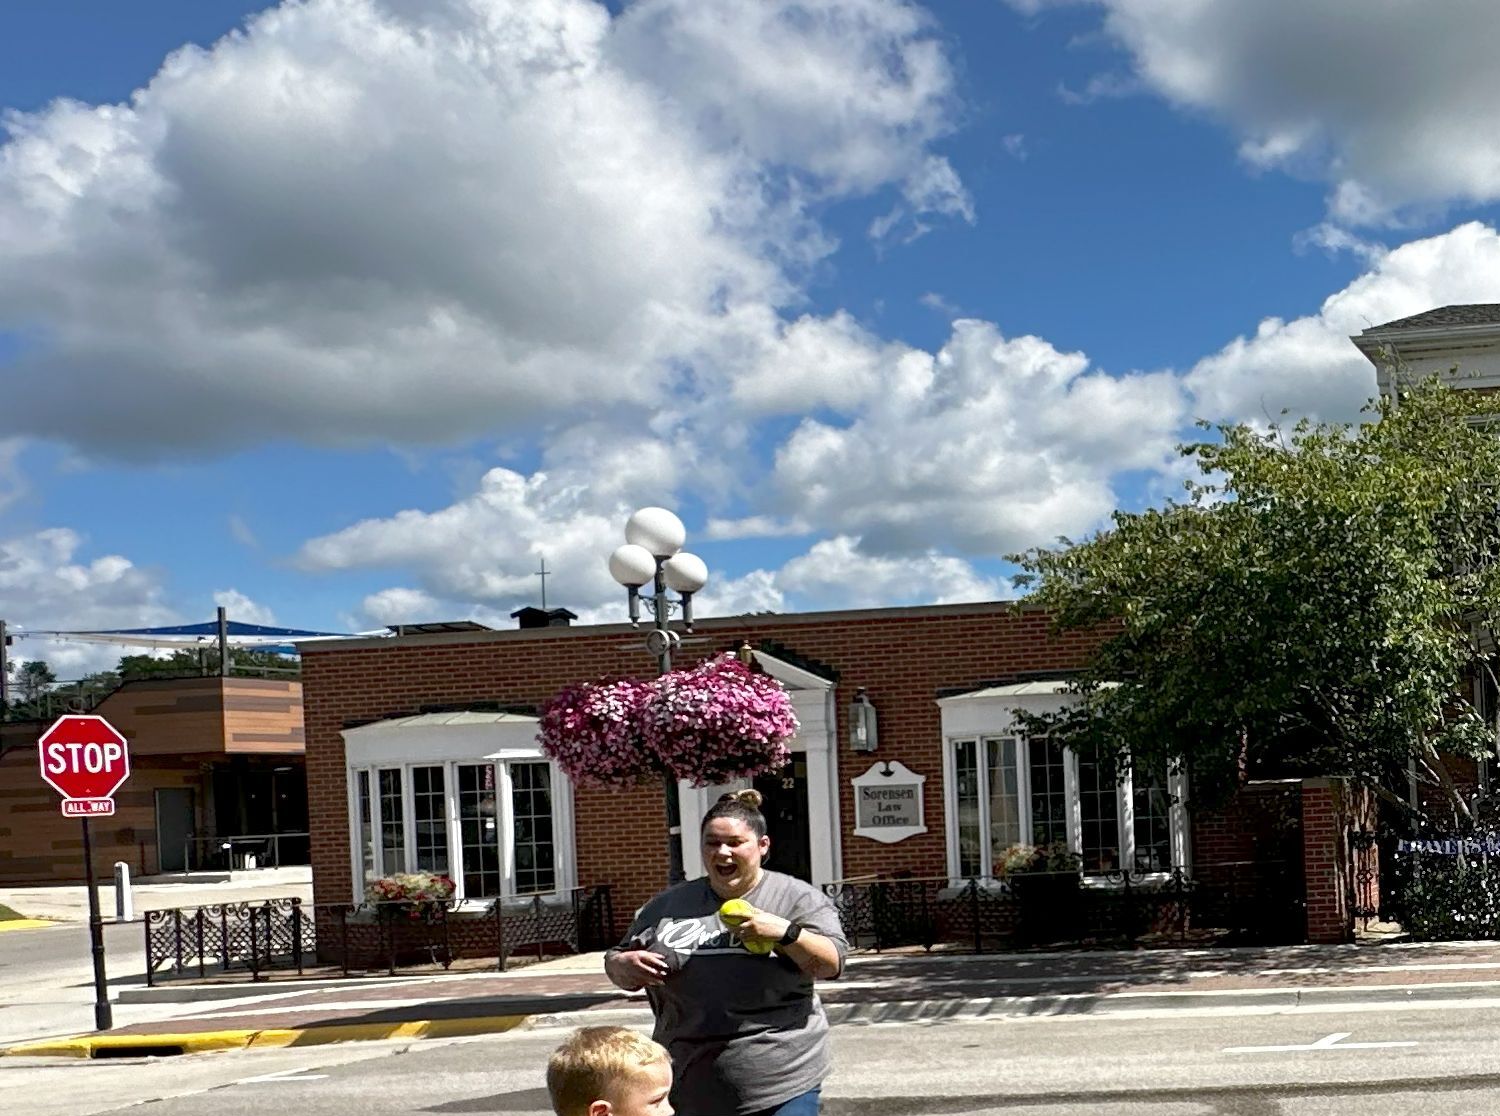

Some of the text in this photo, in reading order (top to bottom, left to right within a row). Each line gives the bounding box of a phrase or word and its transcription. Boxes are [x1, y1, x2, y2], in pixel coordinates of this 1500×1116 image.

[47, 742, 122, 774] STOP
[863, 786, 914, 800] Sorensen
[67, 802, 110, 813] ALL WAY
[877, 801, 902, 812] Law
[872, 815, 909, 825] Office
